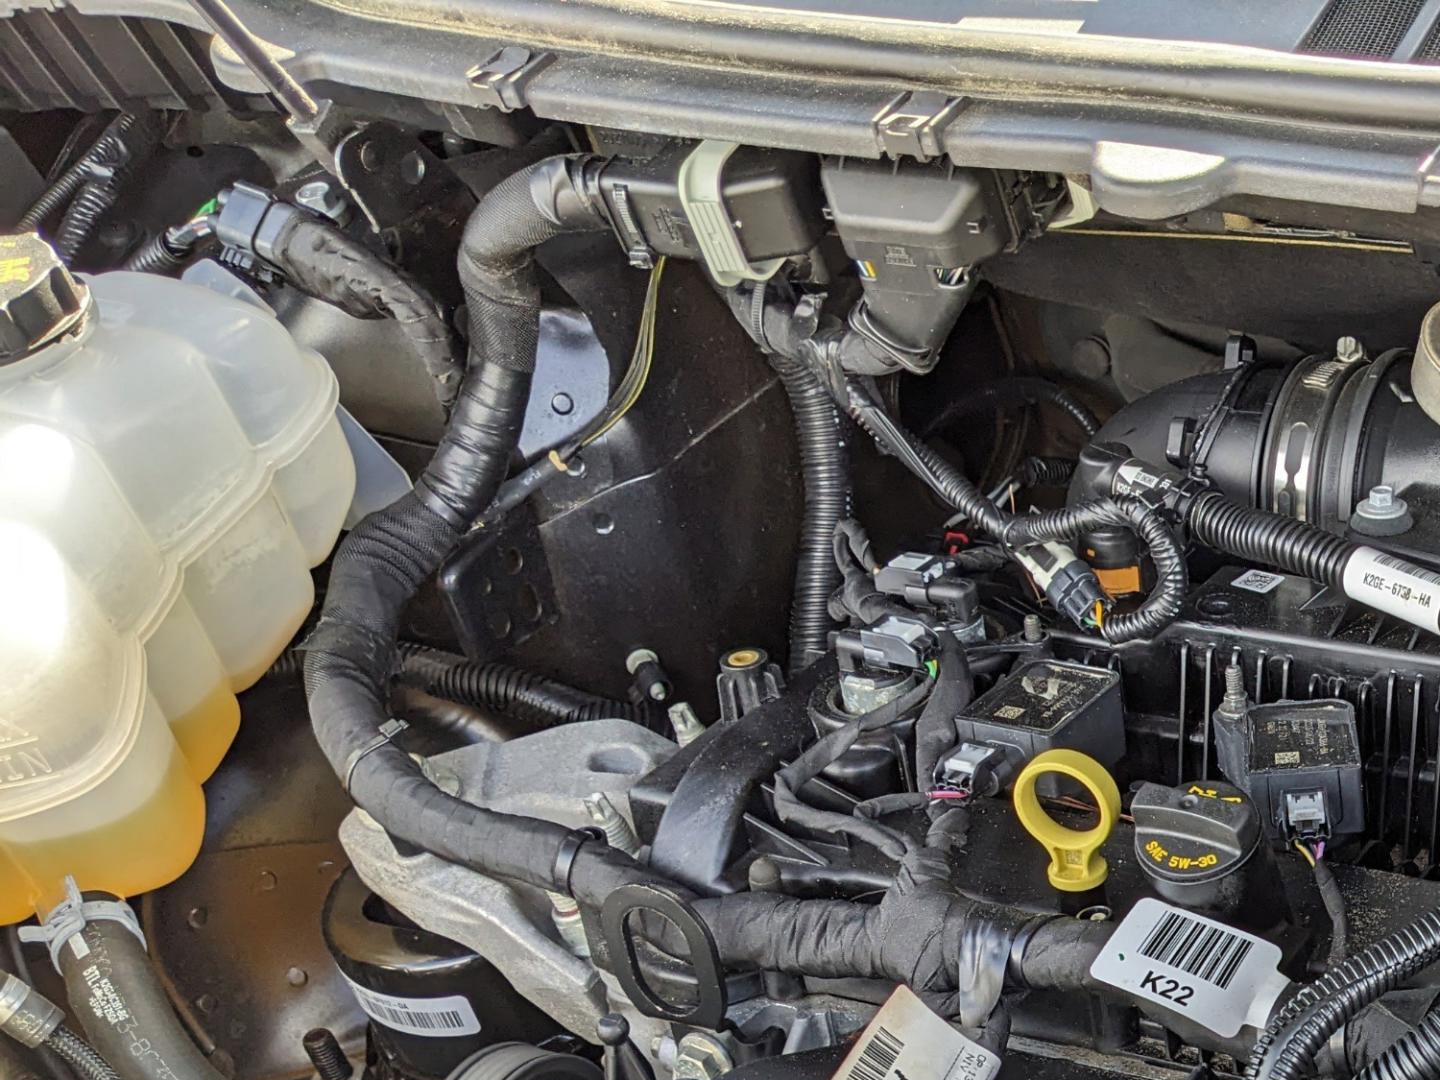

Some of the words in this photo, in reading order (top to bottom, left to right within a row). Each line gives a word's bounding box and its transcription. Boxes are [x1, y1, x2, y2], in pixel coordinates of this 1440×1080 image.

[1145, 840, 1168, 863] SAE
[1168, 854, 1218, 870] 5W-30
[1139, 970, 1195, 1007] K22
